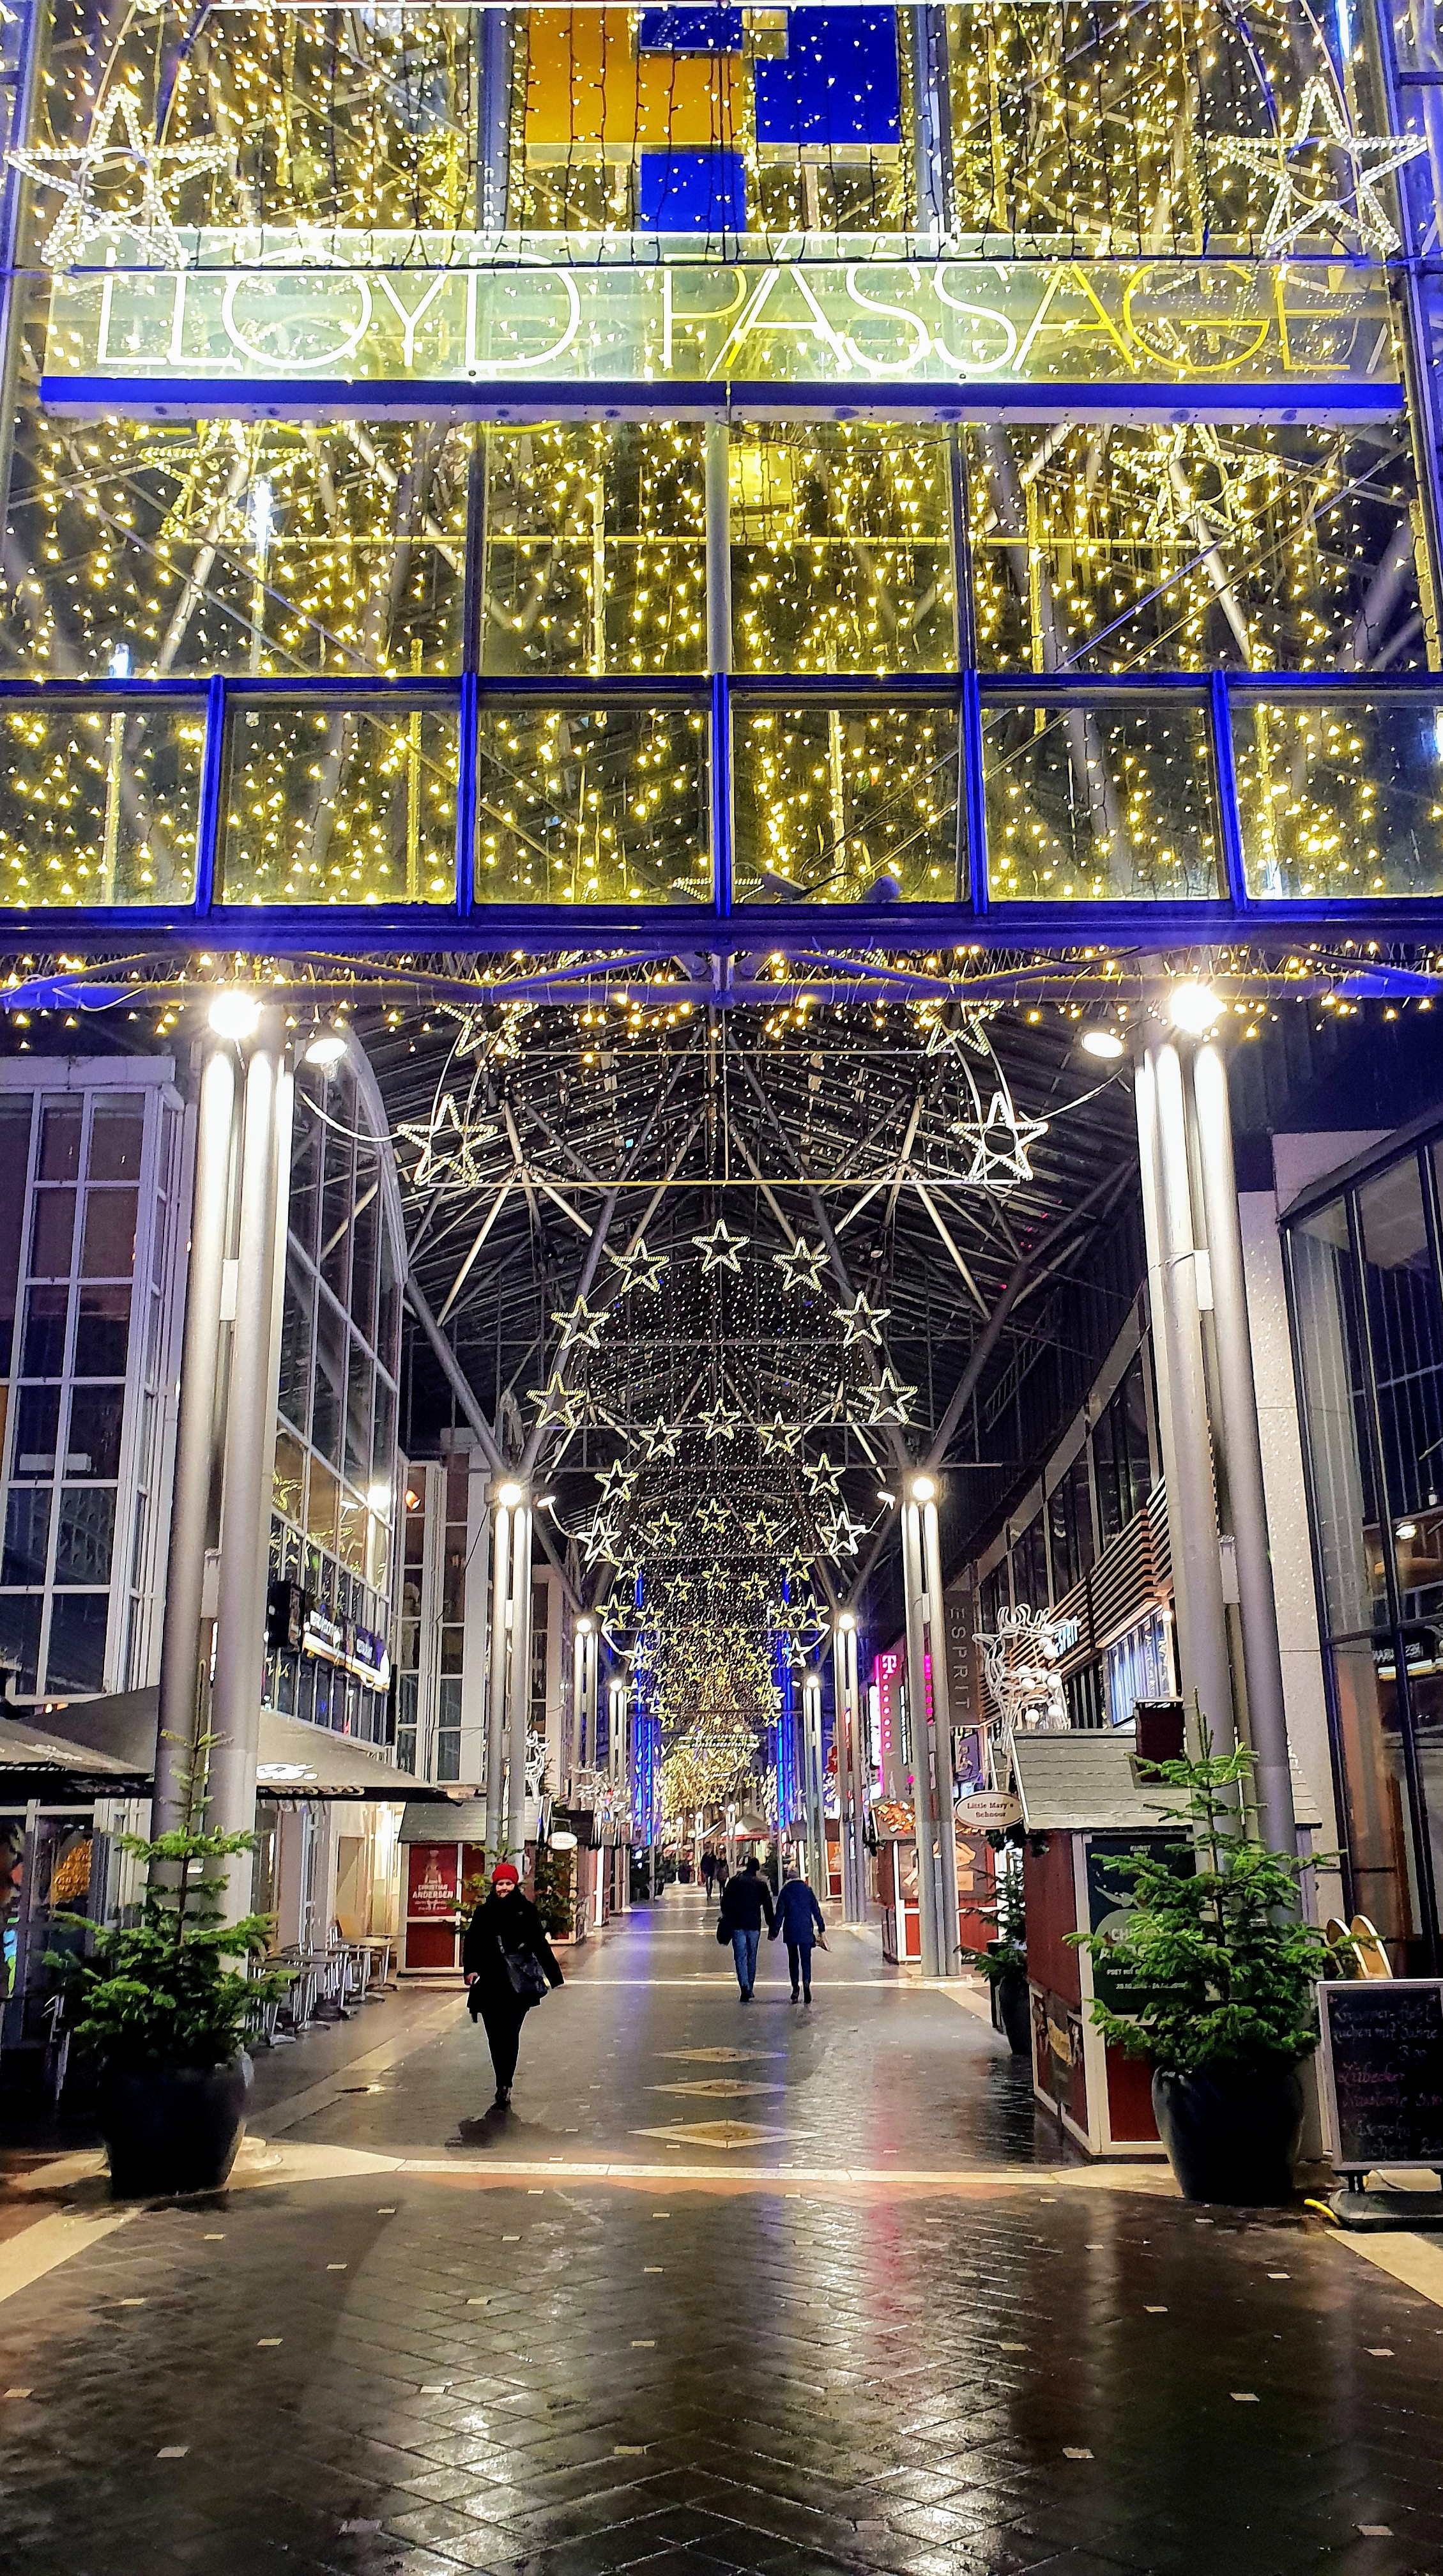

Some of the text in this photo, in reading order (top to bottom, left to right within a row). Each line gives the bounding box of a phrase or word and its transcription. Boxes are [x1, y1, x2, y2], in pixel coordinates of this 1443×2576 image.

[96, 247, 1350, 372] LLOYD PASSAGE
[950, 1608, 970, 1709] ESPRIT
